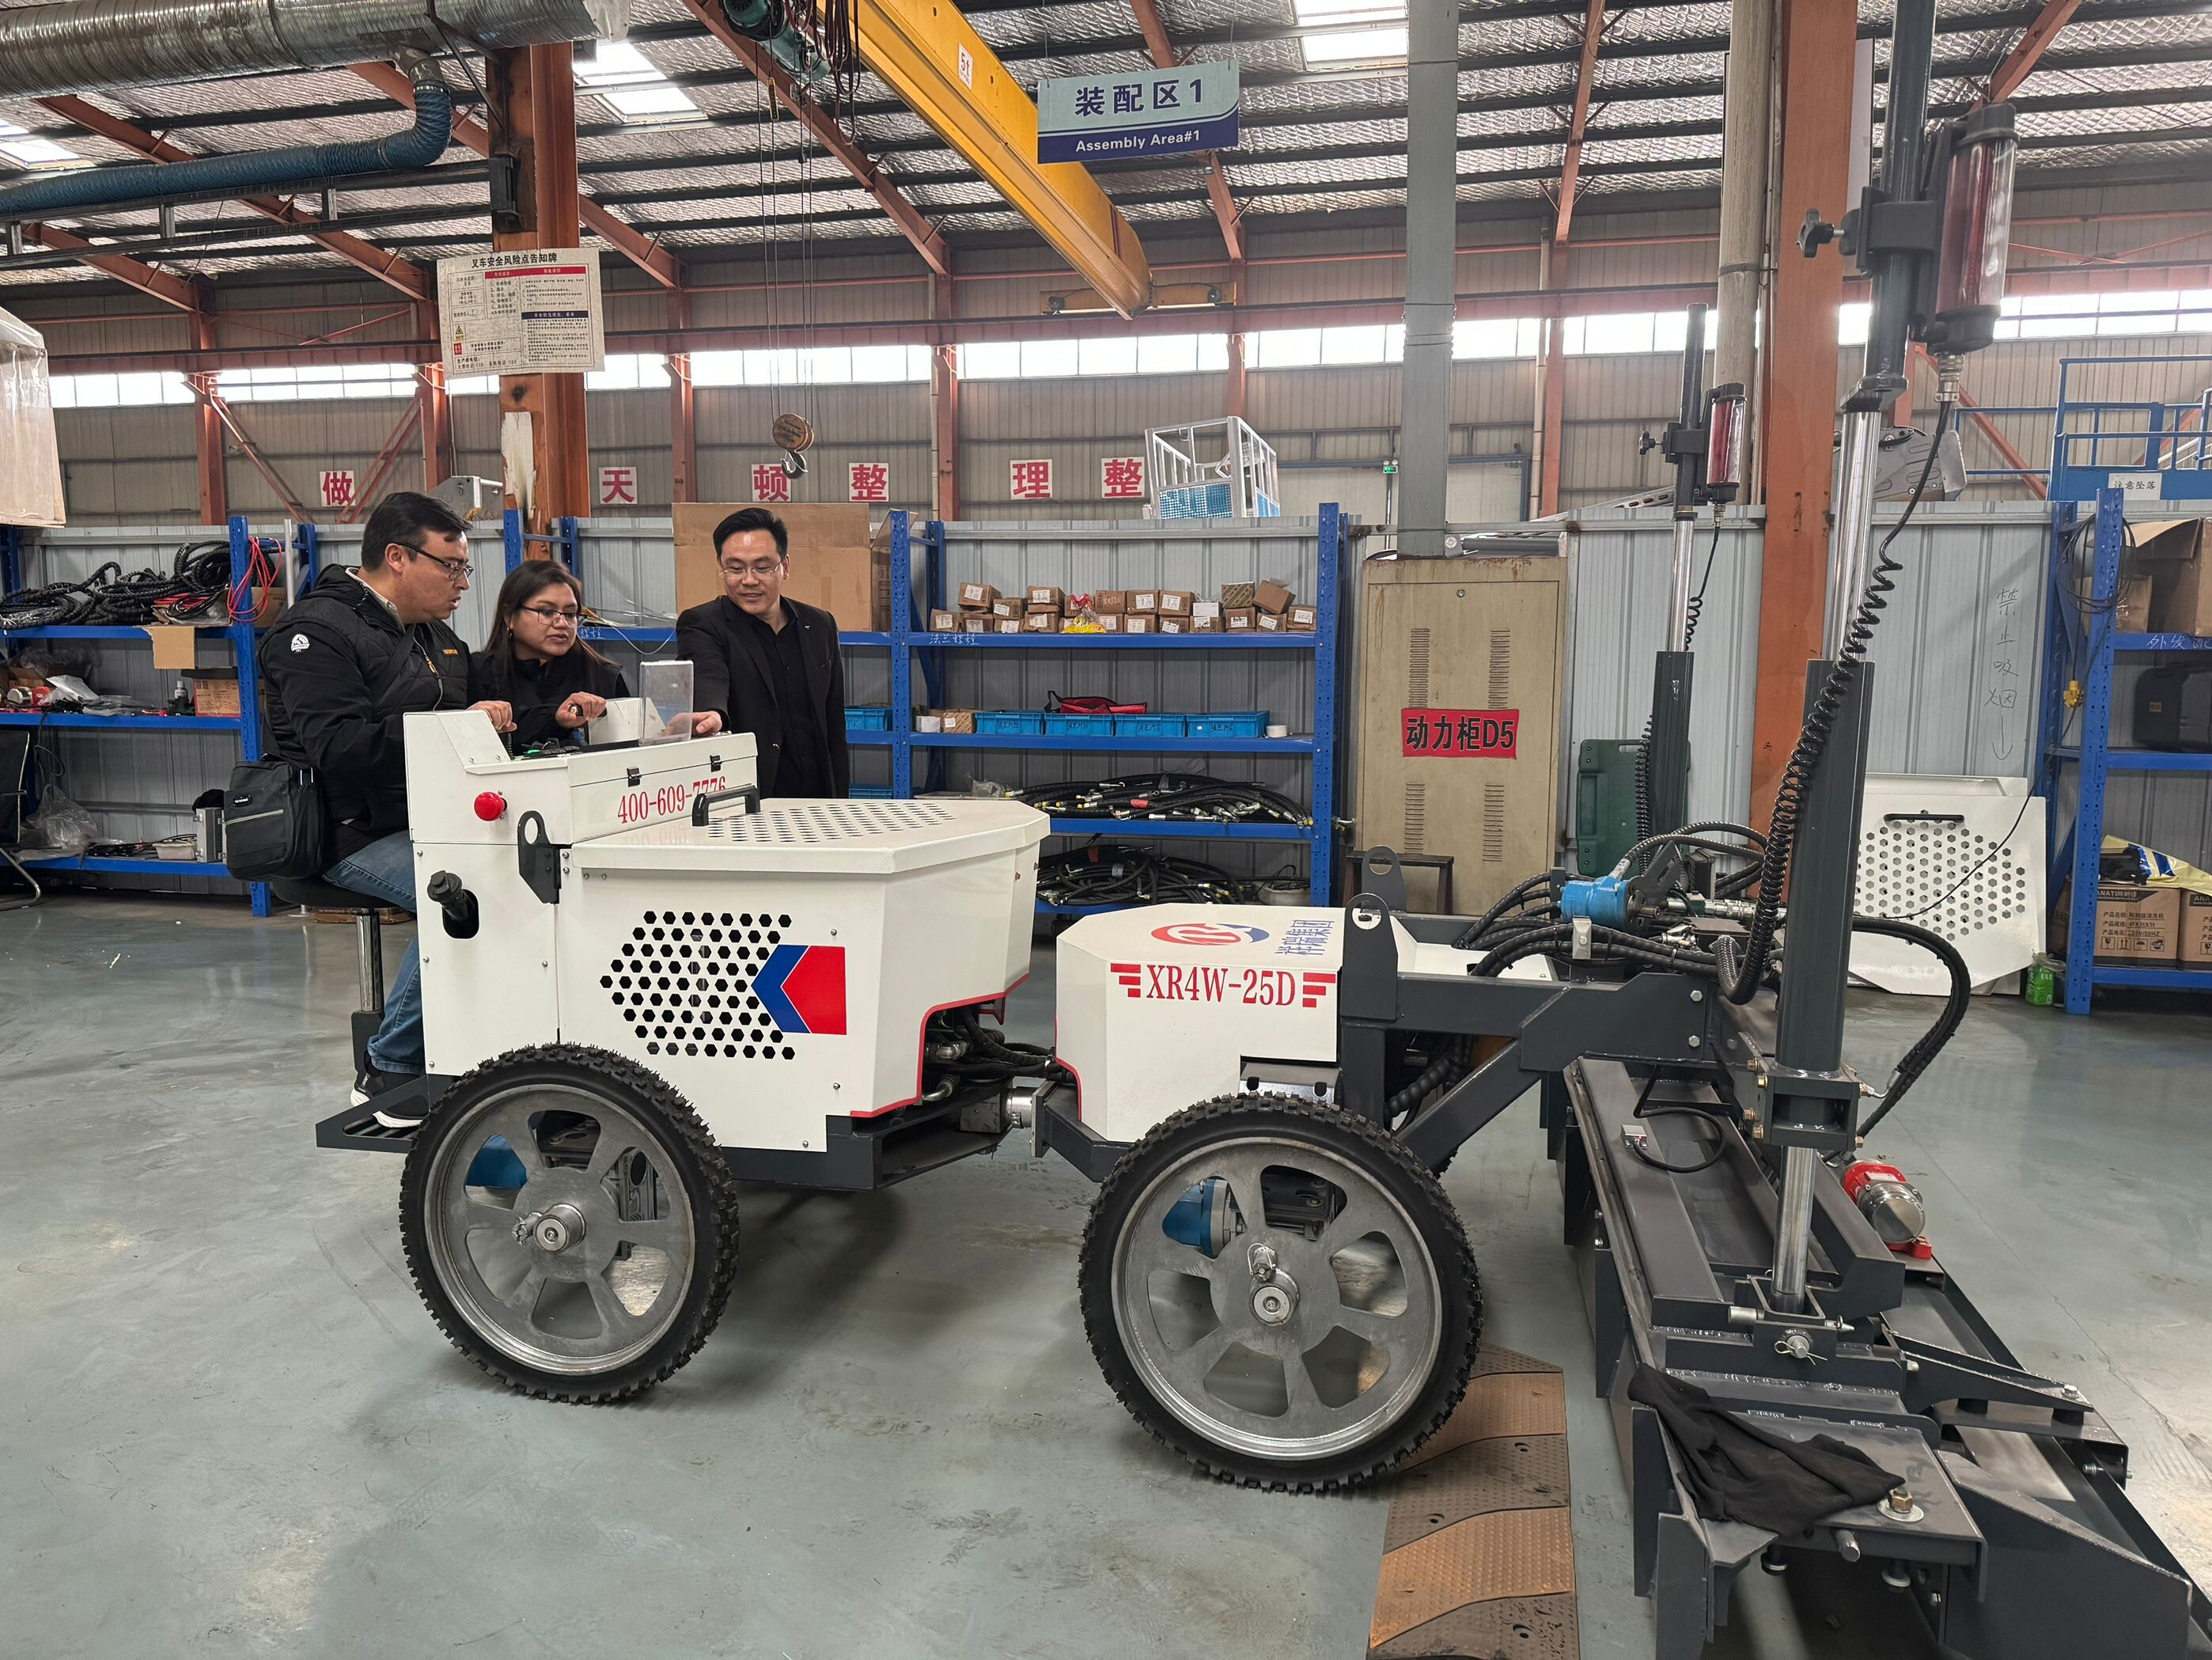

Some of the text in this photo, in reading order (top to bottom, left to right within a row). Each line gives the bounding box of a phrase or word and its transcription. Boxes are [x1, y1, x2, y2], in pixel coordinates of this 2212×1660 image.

[1074, 78, 1203, 117] 装配区1
[1075, 129, 1201, 153] Assembly Area#1
[472, 252, 558, 268] 叉车安全风险点告知牌
[322, 472, 353, 506] 做
[602, 470, 635, 503] 天
[752, 464, 790, 502] 顿
[851, 463, 888, 500] 整
[1012, 461, 1052, 498] 理
[1104, 457, 1144, 497] 整
[2114, 480, 2157, 490] 注意坠落
[1984, 588, 2019, 709] 禁止吸烟
[1405, 714, 1515, 750] 动力柜D5
[1146, 964, 1296, 1008] XR4W-25D
